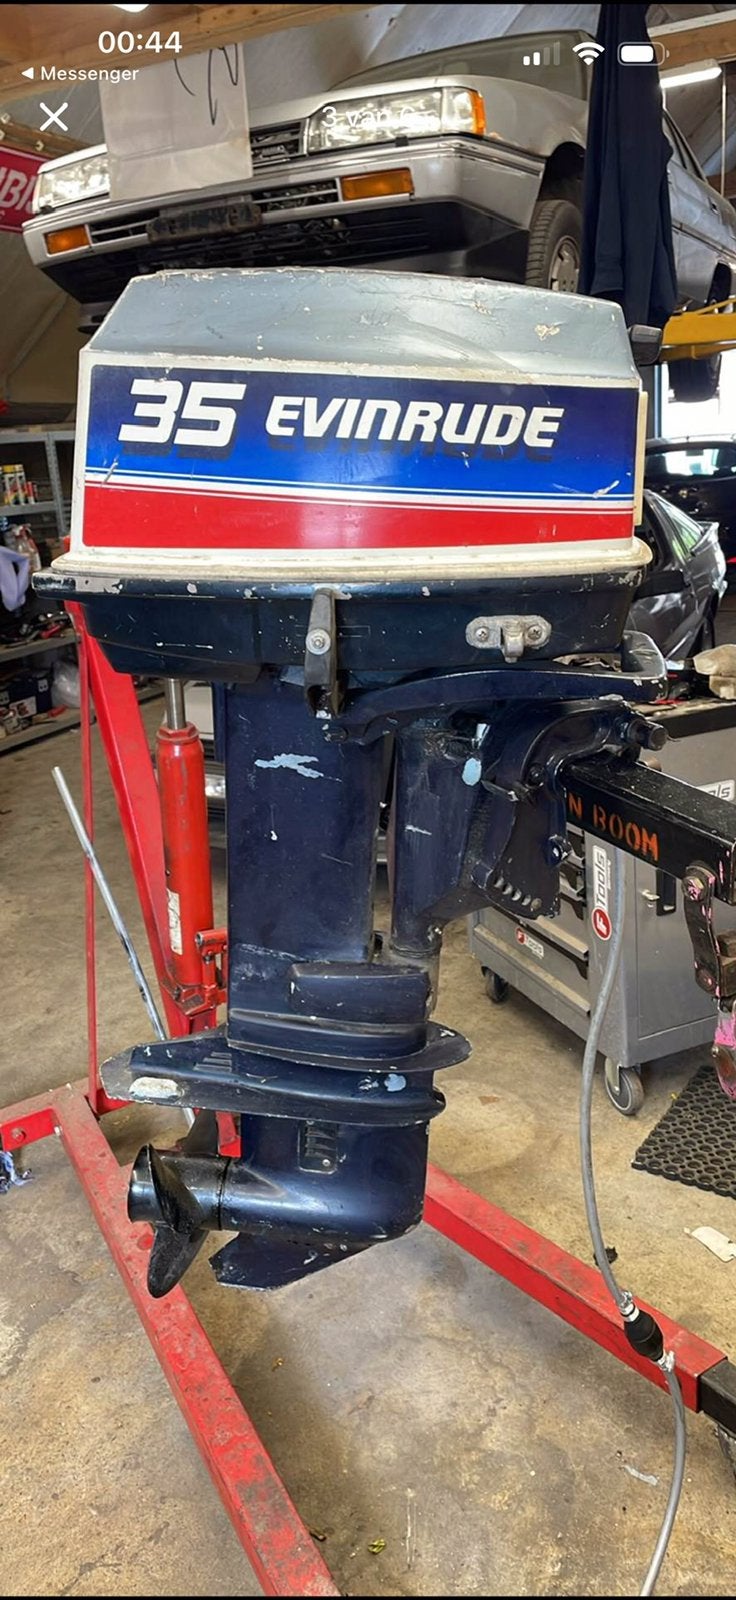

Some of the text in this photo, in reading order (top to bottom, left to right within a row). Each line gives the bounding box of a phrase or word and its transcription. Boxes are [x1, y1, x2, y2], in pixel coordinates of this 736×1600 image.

[117, 378, 565, 449] 35 EVINRUDE
[592, 803, 660, 862] BOOM
